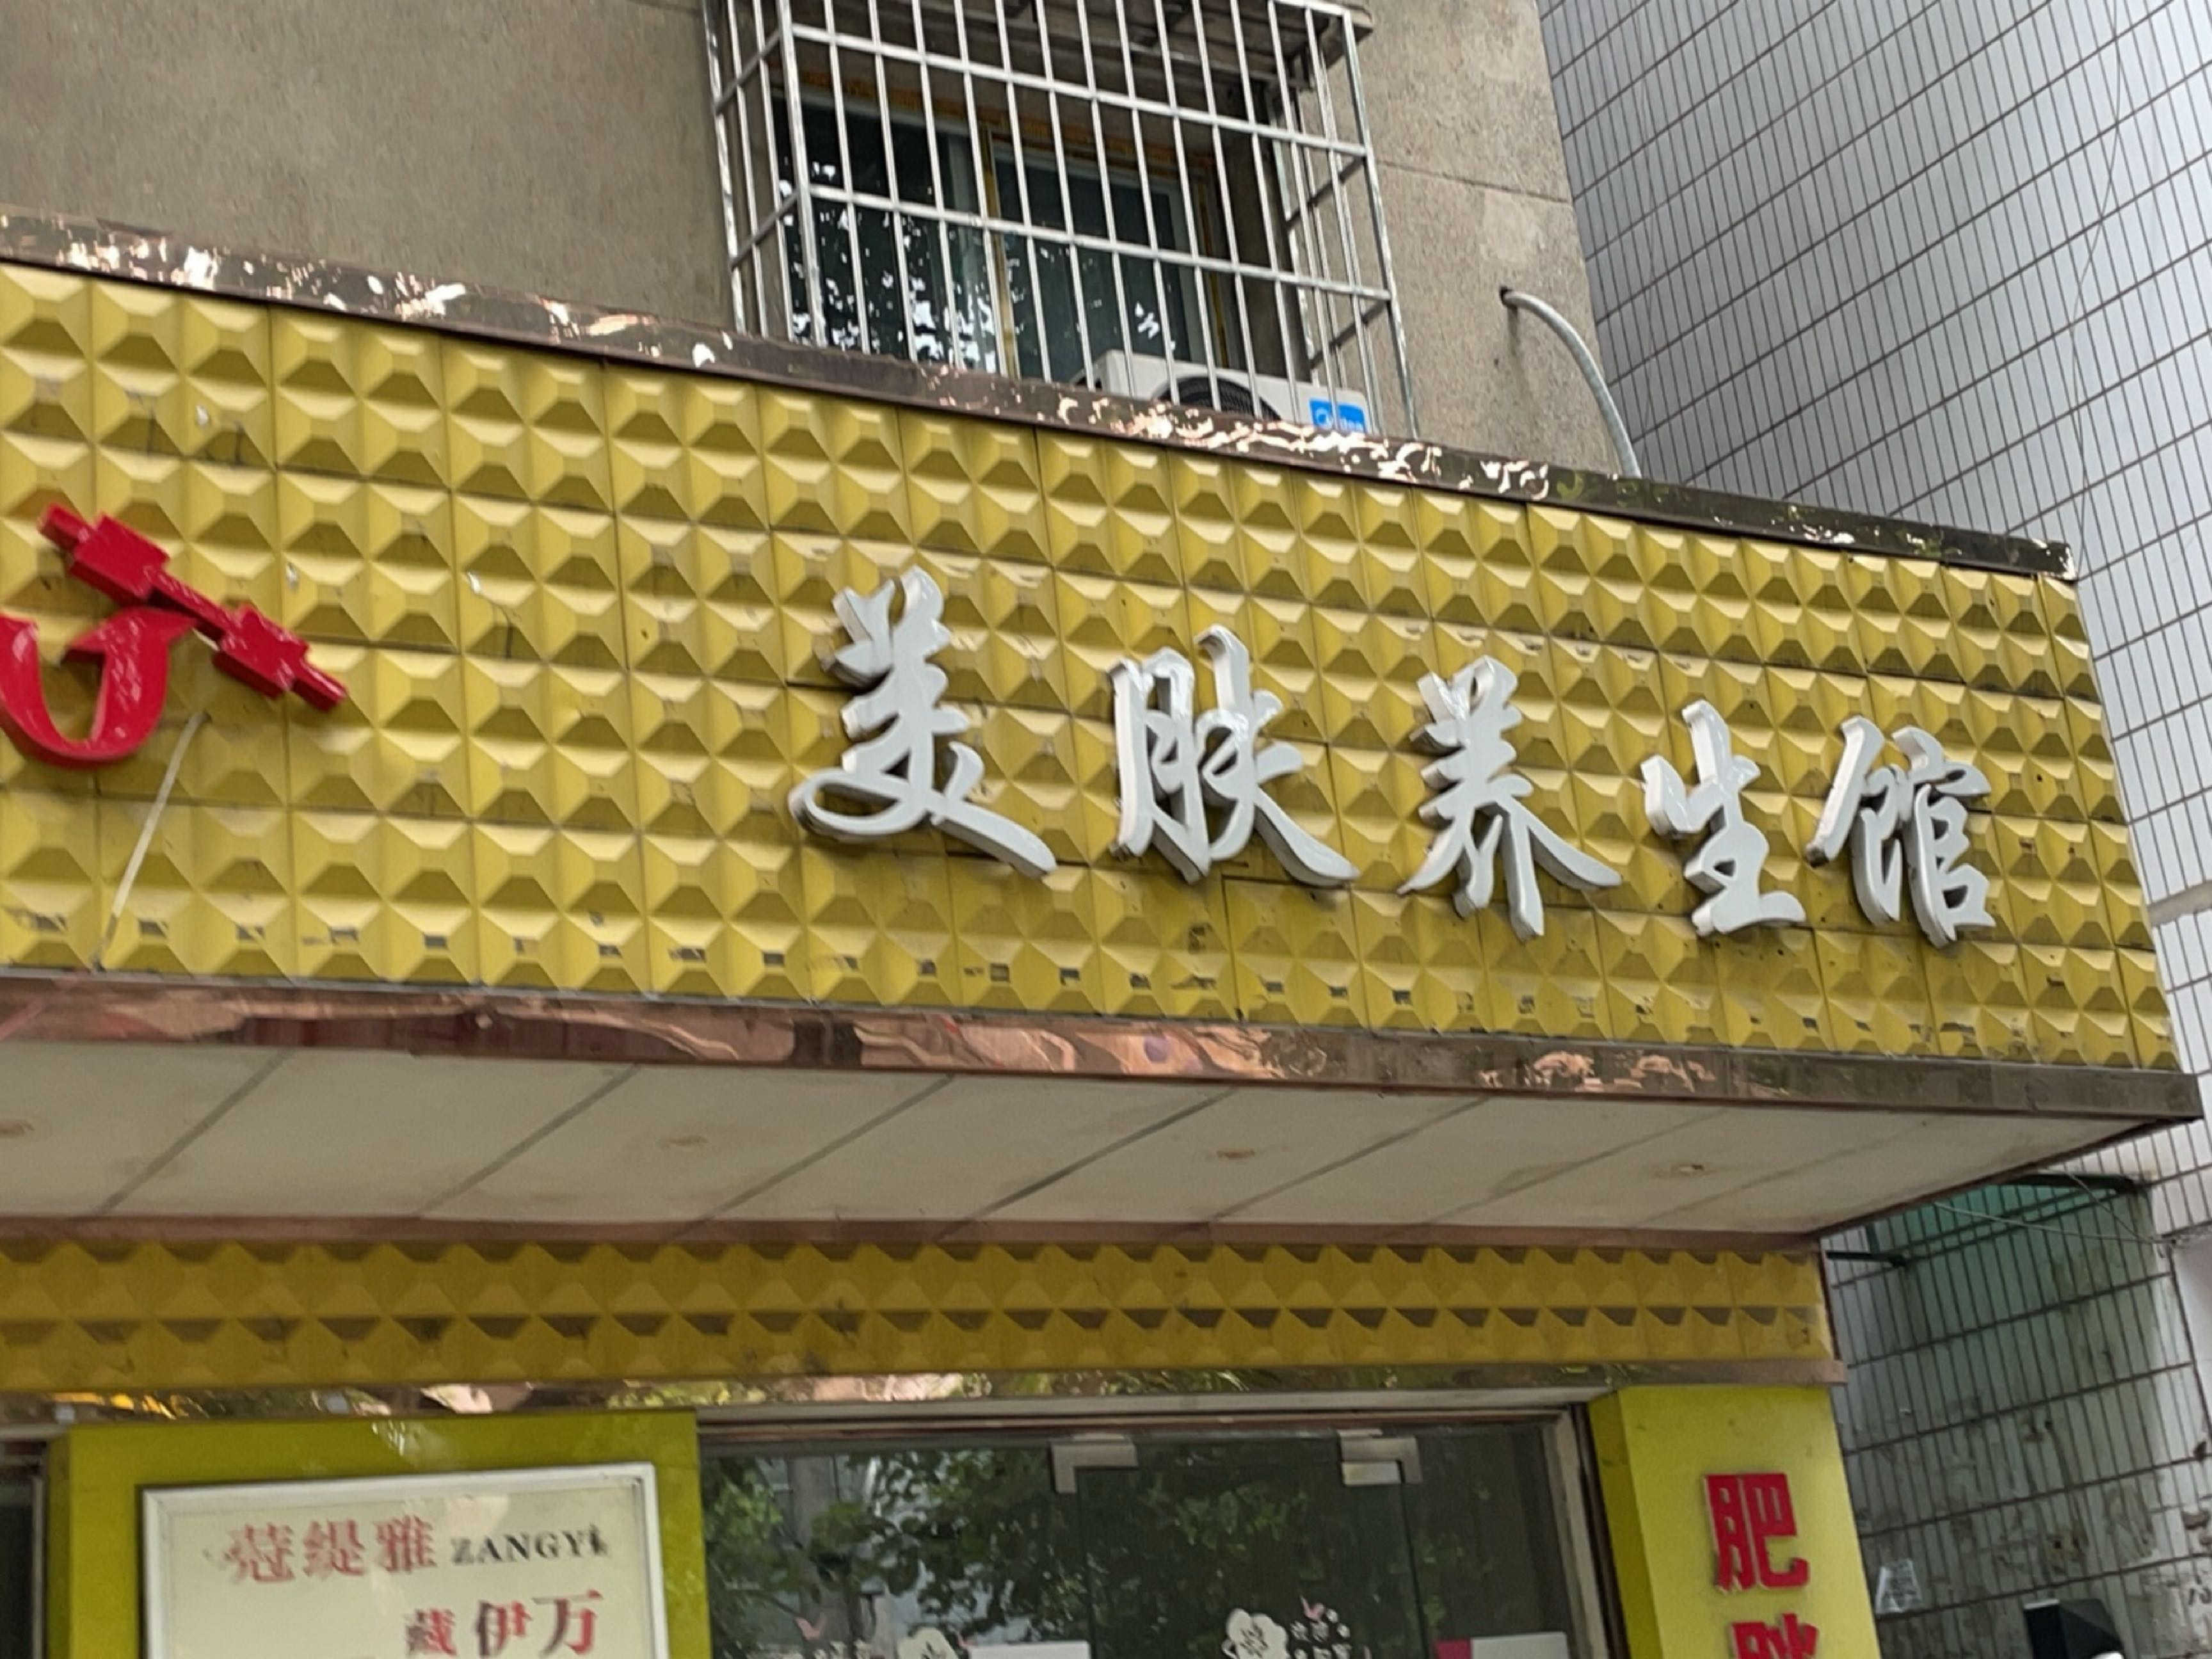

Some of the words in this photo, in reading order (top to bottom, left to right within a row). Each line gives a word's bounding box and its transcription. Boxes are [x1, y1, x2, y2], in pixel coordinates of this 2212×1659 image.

[789, 567, 1993, 946] 美肤养生馆
